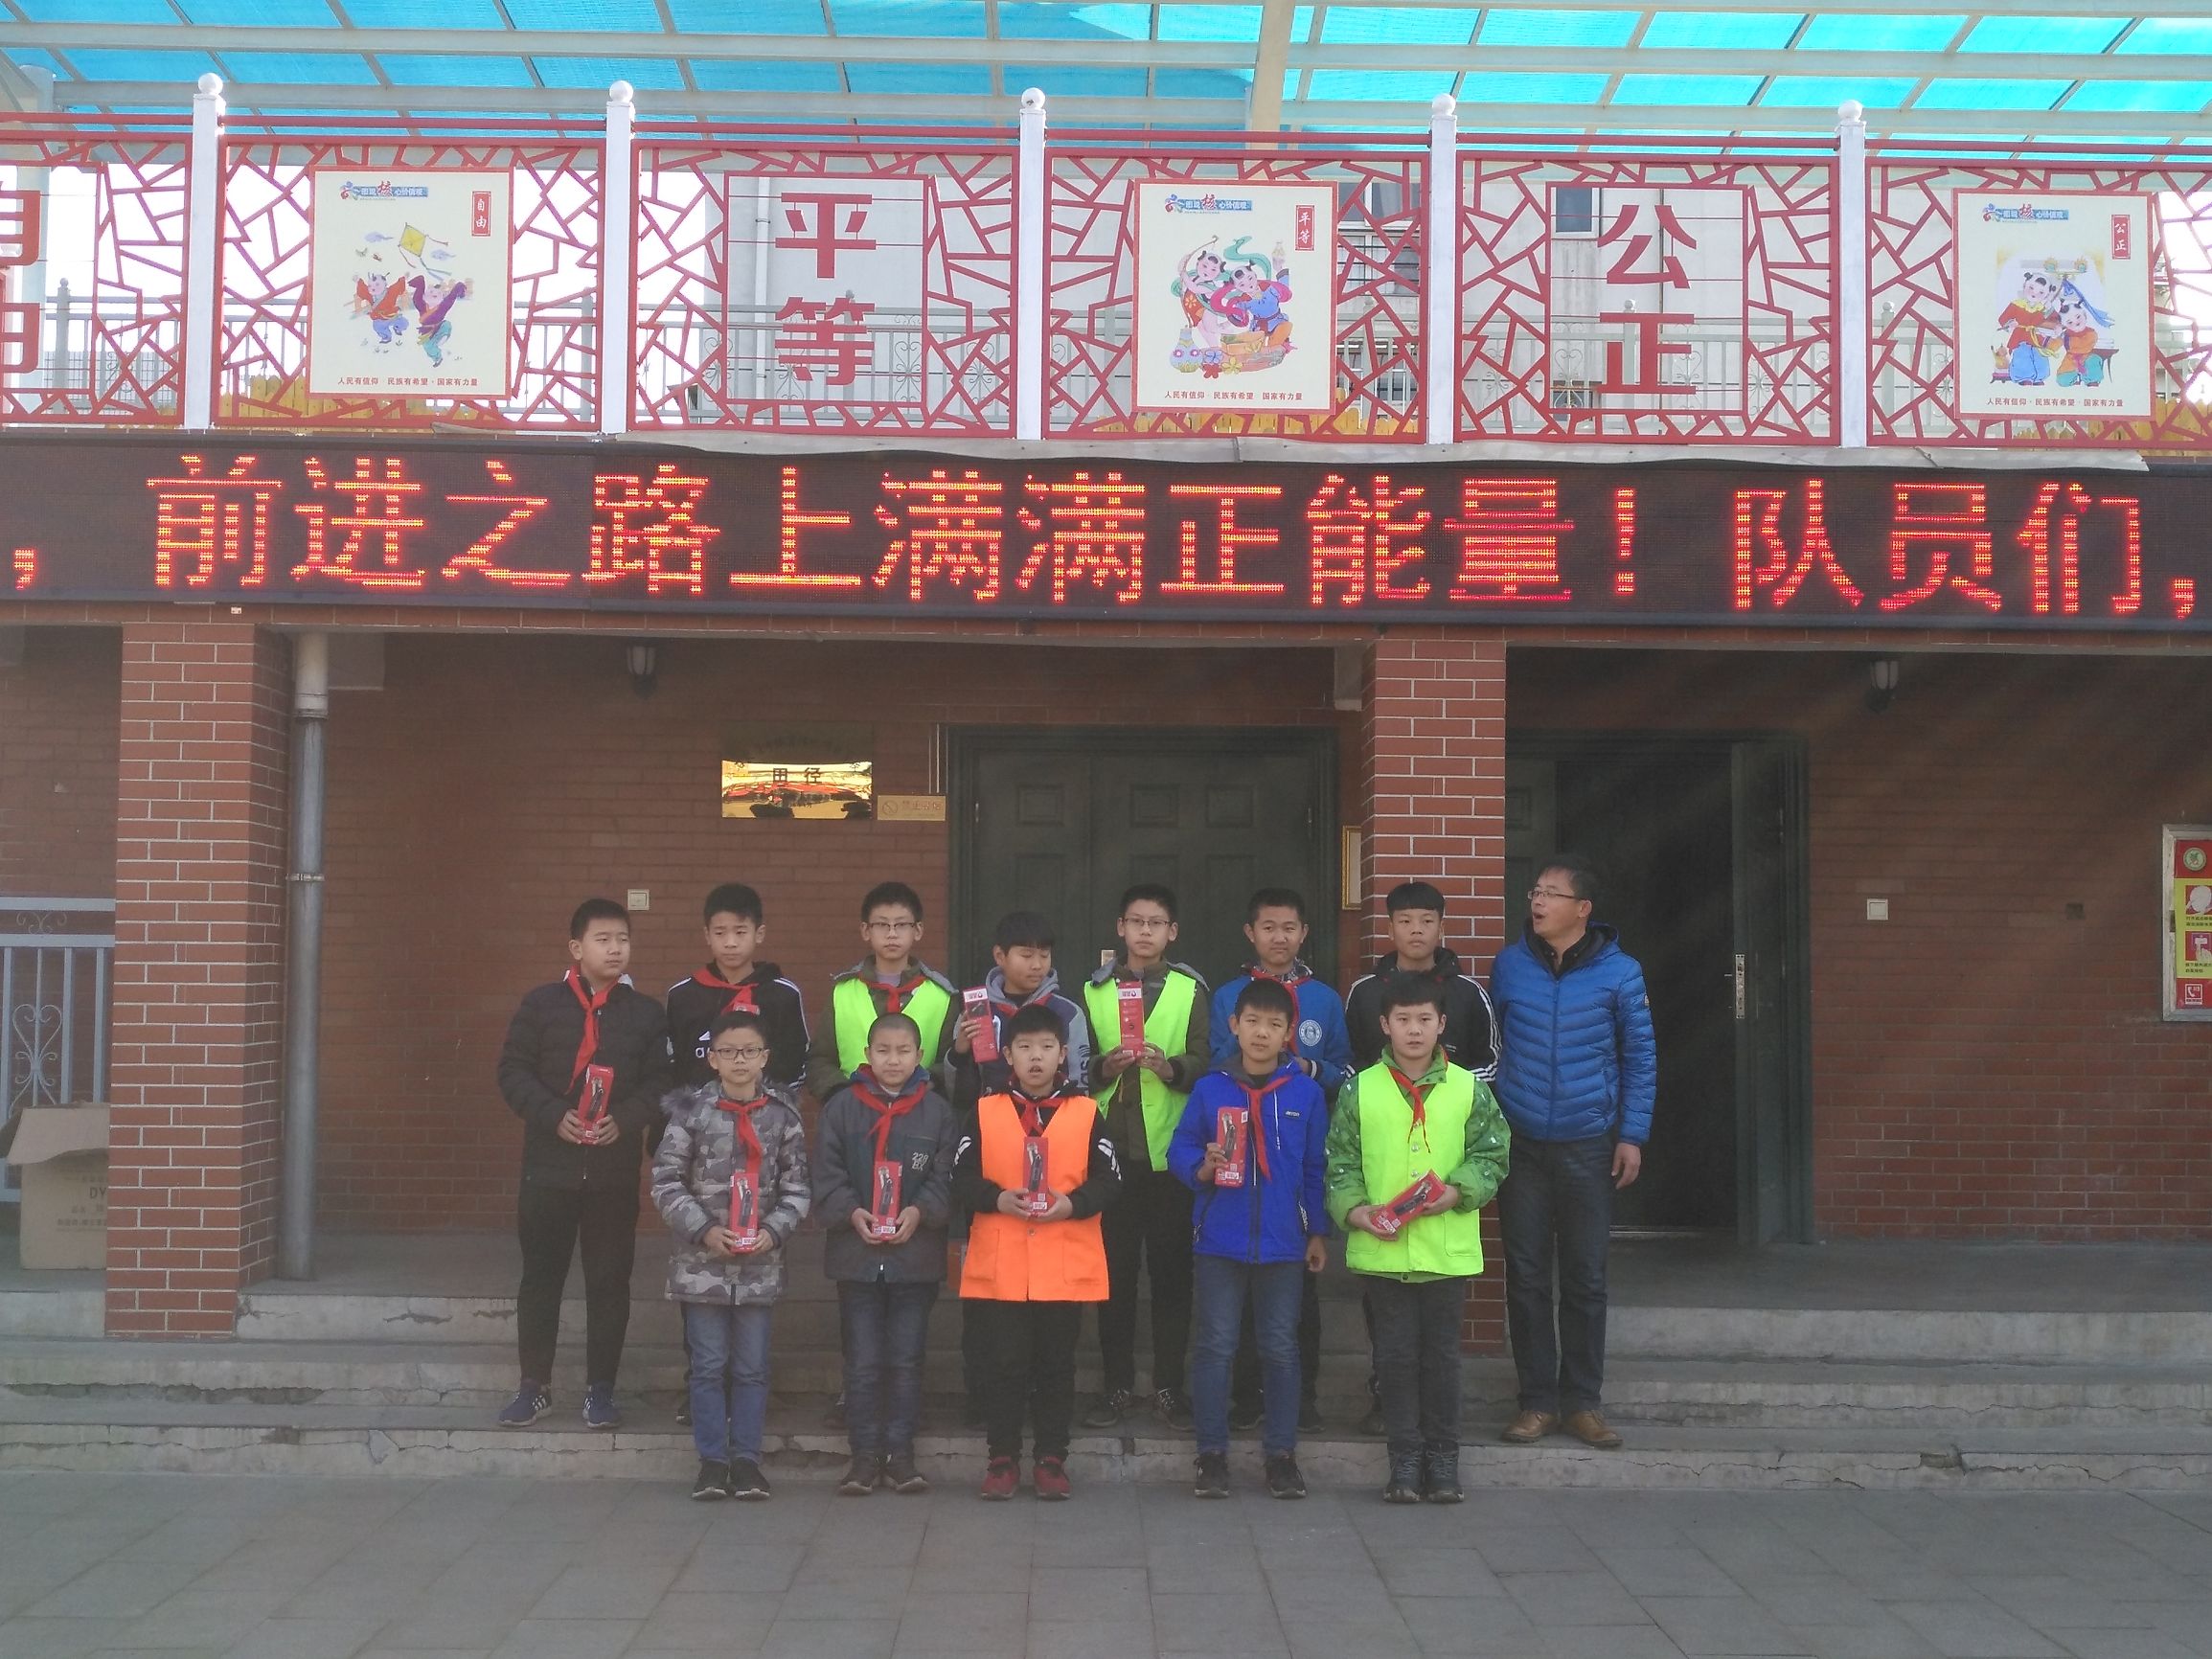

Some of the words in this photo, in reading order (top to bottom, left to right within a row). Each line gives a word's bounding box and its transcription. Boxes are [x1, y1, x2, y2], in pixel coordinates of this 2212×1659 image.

[475, 198, 487, 229] 自由
[1298, 212, 1311, 244] 平等
[2114, 222, 2127, 252] 公正
[774, 192, 877, 386] 平等
[1596, 203, 1697, 396] 公正
[773, 766, 822, 784] 田径
